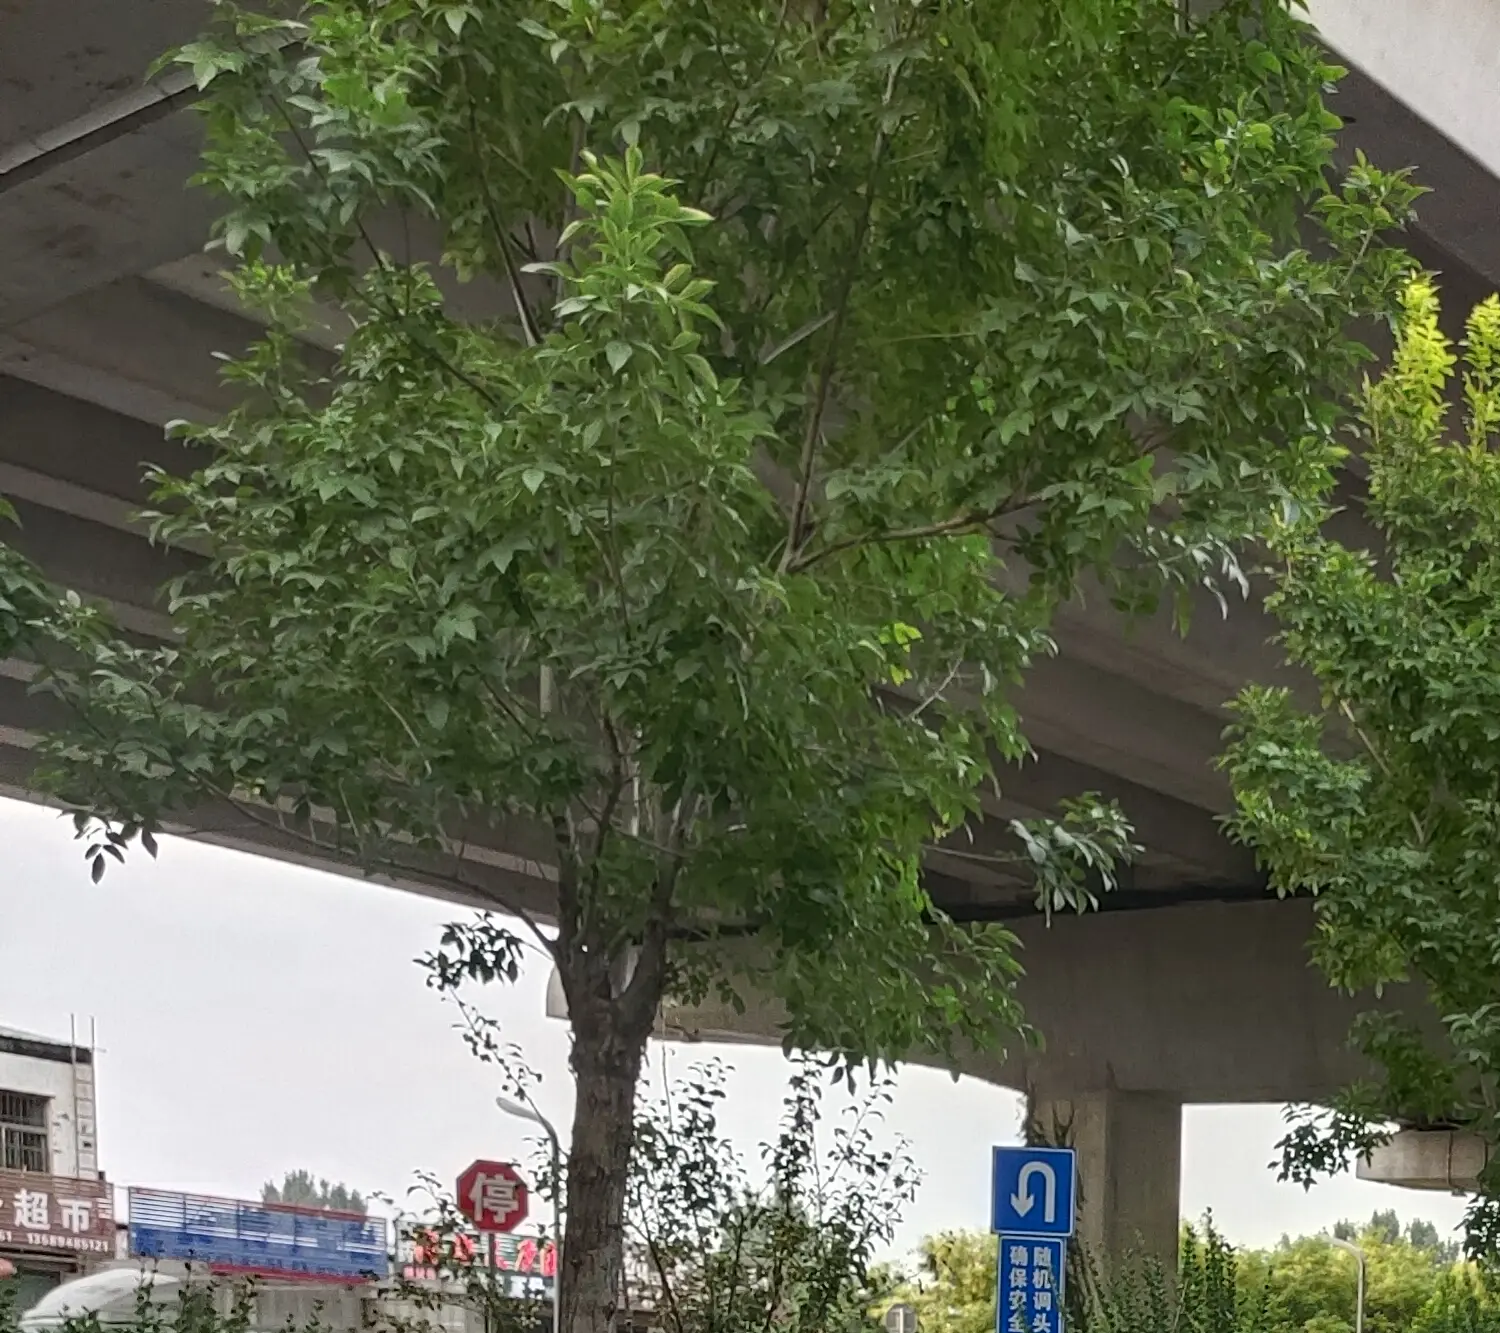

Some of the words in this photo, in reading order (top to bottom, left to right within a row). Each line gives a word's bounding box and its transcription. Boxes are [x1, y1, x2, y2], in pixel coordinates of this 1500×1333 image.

[0, 1187, 93, 1234] 超市
[468, 1171, 519, 1224] 停
[1008, 1245, 1028, 1333] 确保安全
[1032, 1246, 1052, 1333] 随机调头
